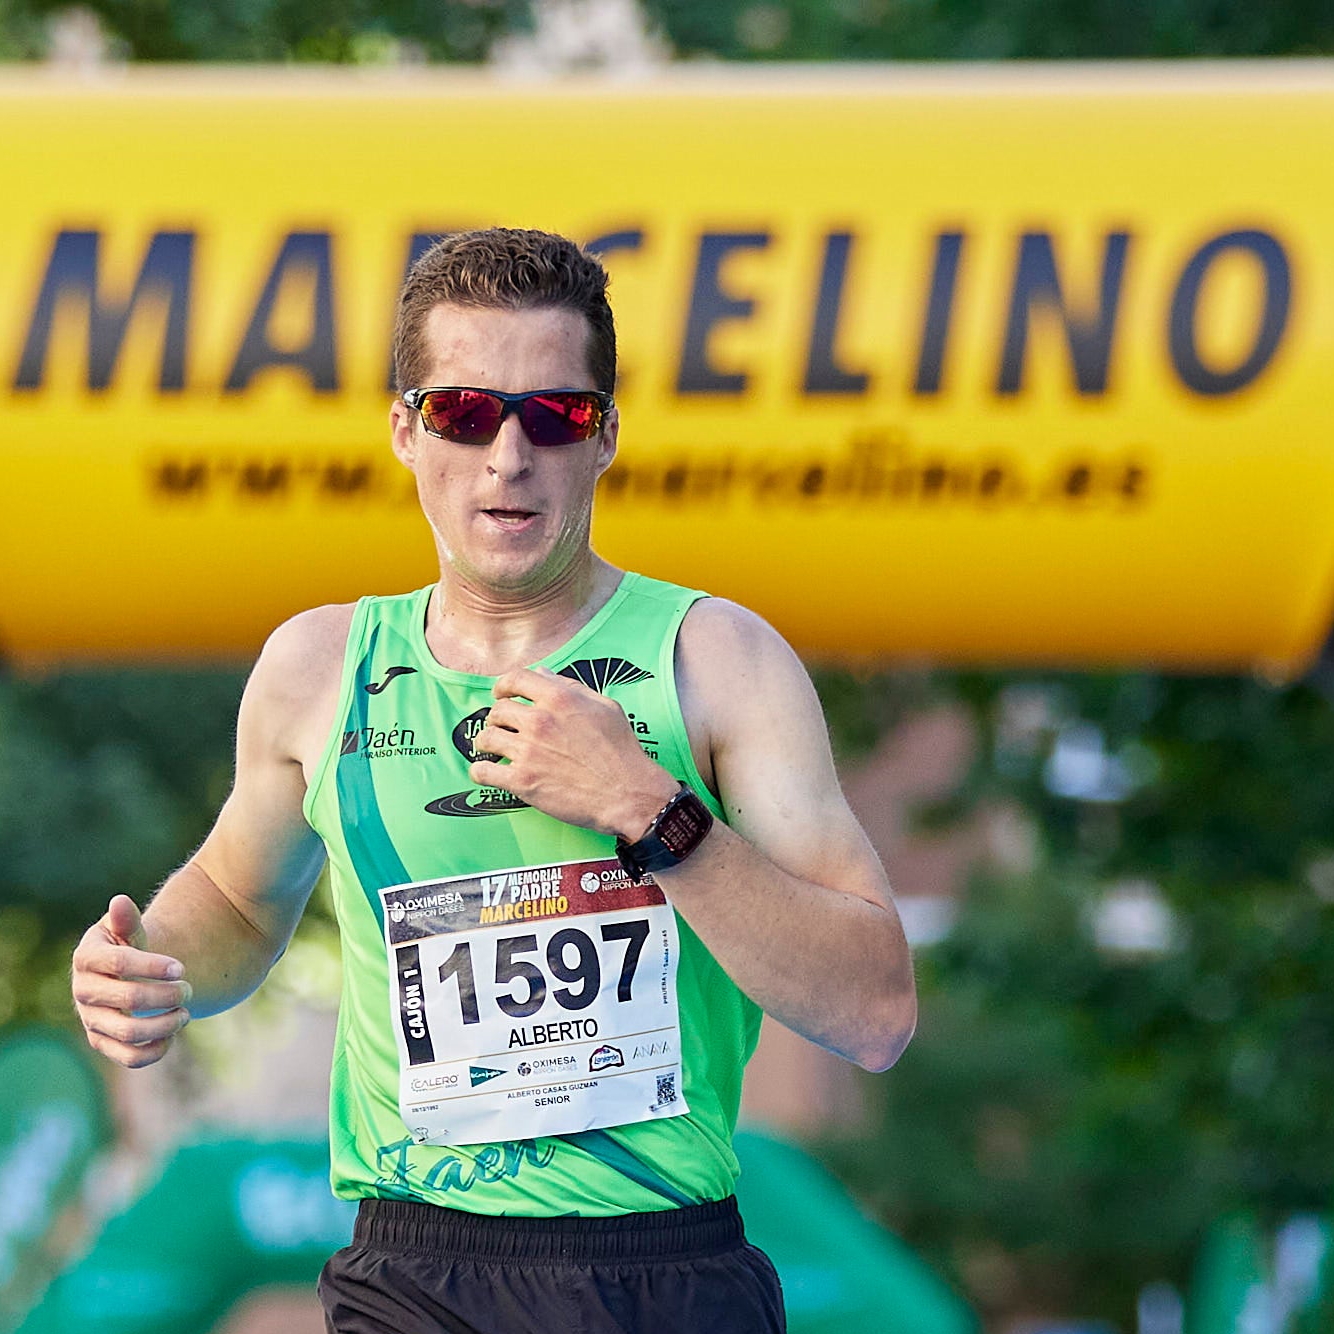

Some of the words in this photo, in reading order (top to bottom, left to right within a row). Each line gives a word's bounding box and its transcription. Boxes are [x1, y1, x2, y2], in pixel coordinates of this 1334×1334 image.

[10, 228, 1294, 396] MAELINO
[361, 722, 415, 750] Jaén
[394, 746, 437, 756] INTERIOR
[508, 868, 563, 886] MEMORIAL
[406, 892, 464, 910] OXIMESA
[480, 875, 508, 907] 17
[511, 881, 560, 903] PADRE
[479, 896, 568, 924] MARCELINO
[403, 968, 419, 979] 1
[438, 918, 651, 1025] 1597
[403, 983, 426, 1039] CAJÓN
[508, 1018, 599, 1049] ALBERTO
[532, 1056, 577, 1069] OXIMESA
[413, 1075, 458, 1091] CALERO
[507, 1088, 541, 1099] ALBERTO
[542, 1084, 568, 1094] CASAS
[568, 1081, 599, 1092] GUZMAN
[534, 1095, 571, 1107] SENIOR
